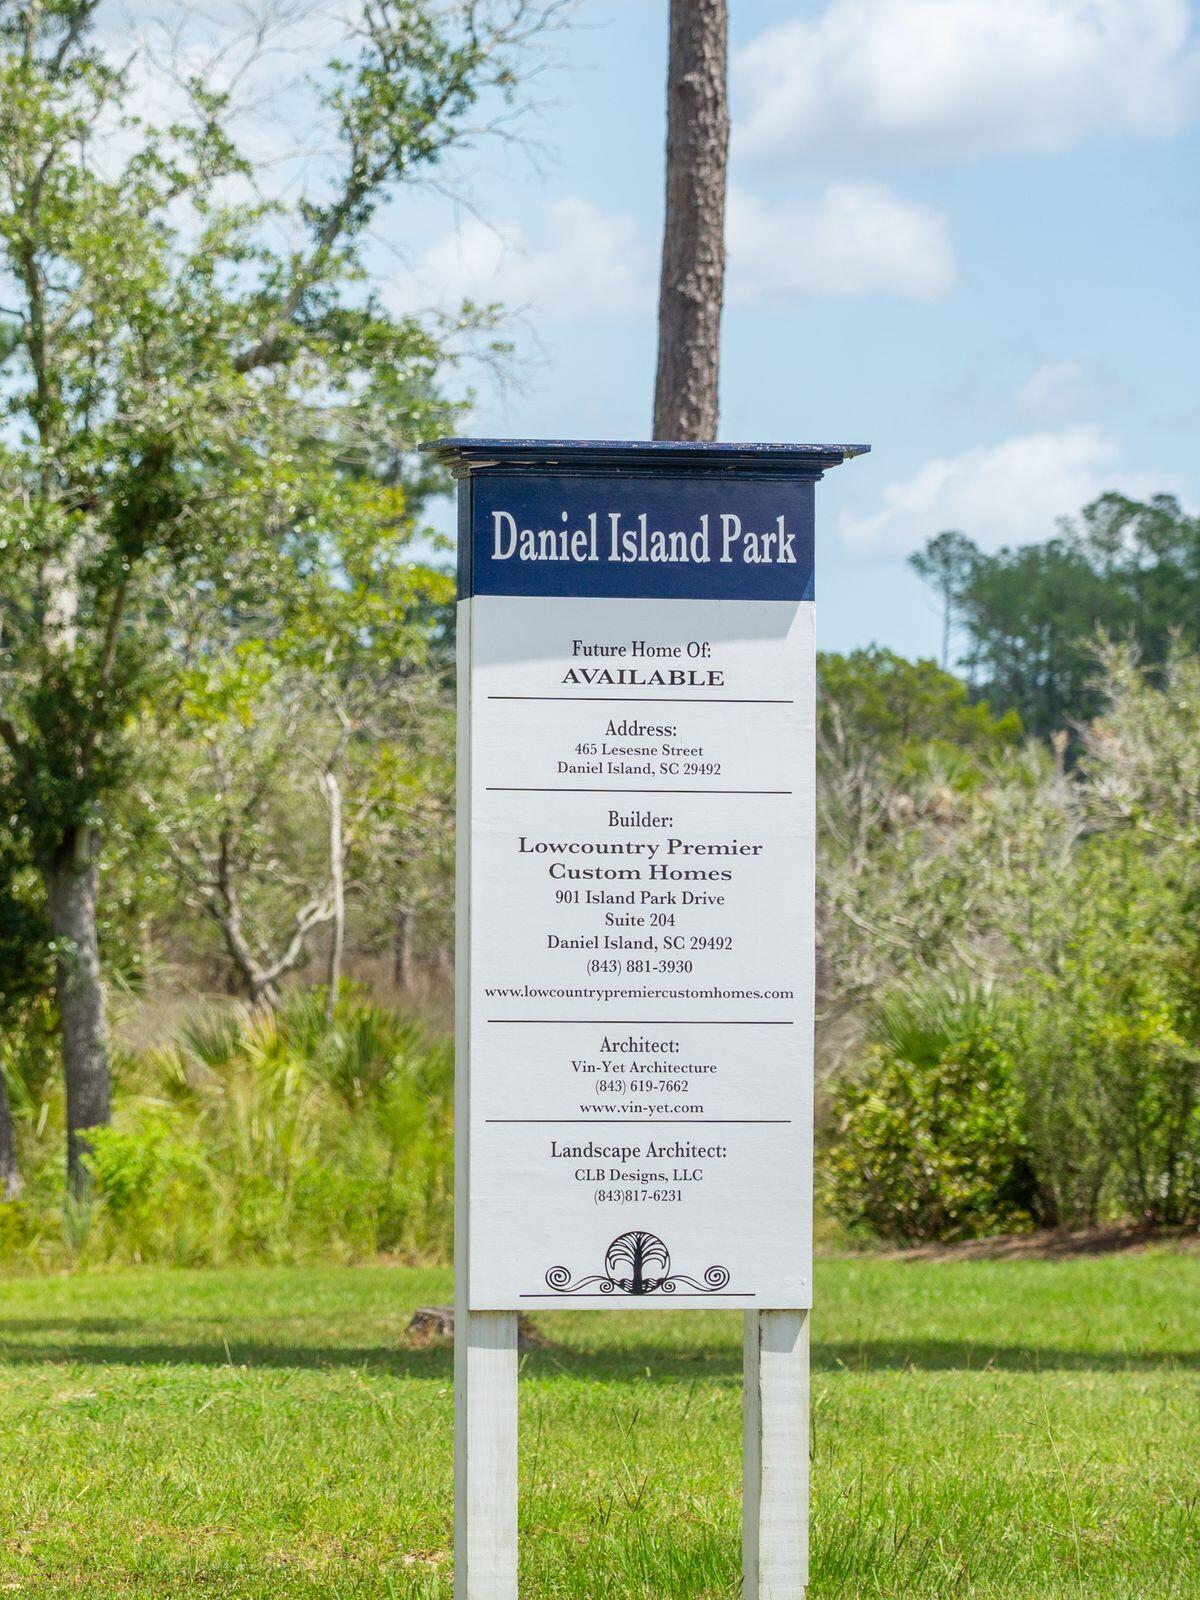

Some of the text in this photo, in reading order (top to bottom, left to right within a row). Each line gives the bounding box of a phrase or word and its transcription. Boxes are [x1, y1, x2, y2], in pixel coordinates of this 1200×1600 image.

[491, 510, 797, 564] Daniel Island Park
[571, 639, 711, 659] Future Home Of:
[560, 667, 725, 687] AVAILABLE
[604, 719, 677, 738] Address:
[574, 742, 704, 757] 465 Lesesne Street
[556, 760, 721, 778] Daniel Island, SC 29492
[607, 809, 673, 828] Builder:
[517, 836, 764, 860] Lowcountry Premier
[548, 862, 733, 882] Custom Homes
[555, 889, 725, 906] 901 Island Park Drive
[604, 911, 676, 928] Suite 204
[546, 934, 733, 953] Daniel Island, SC 29492
[586, 959, 693, 977] (843) 881-3930
[484, 984, 795, 1002] www.lowcountrypremiercustomhomes.com
[599, 1035, 680, 1054] Architect:
[570, 1060, 718, 1074] Vin-Yet Architecture
[595, 1079, 689, 1096] (843) 619-7662
[579, 1100, 705, 1117] www.vin-yet.com
[550, 1140, 727, 1164] Landscape Architect:
[574, 1168, 703, 1186] CLB Designs, LLC
[593, 1189, 683, 1206] (843)817-6231
